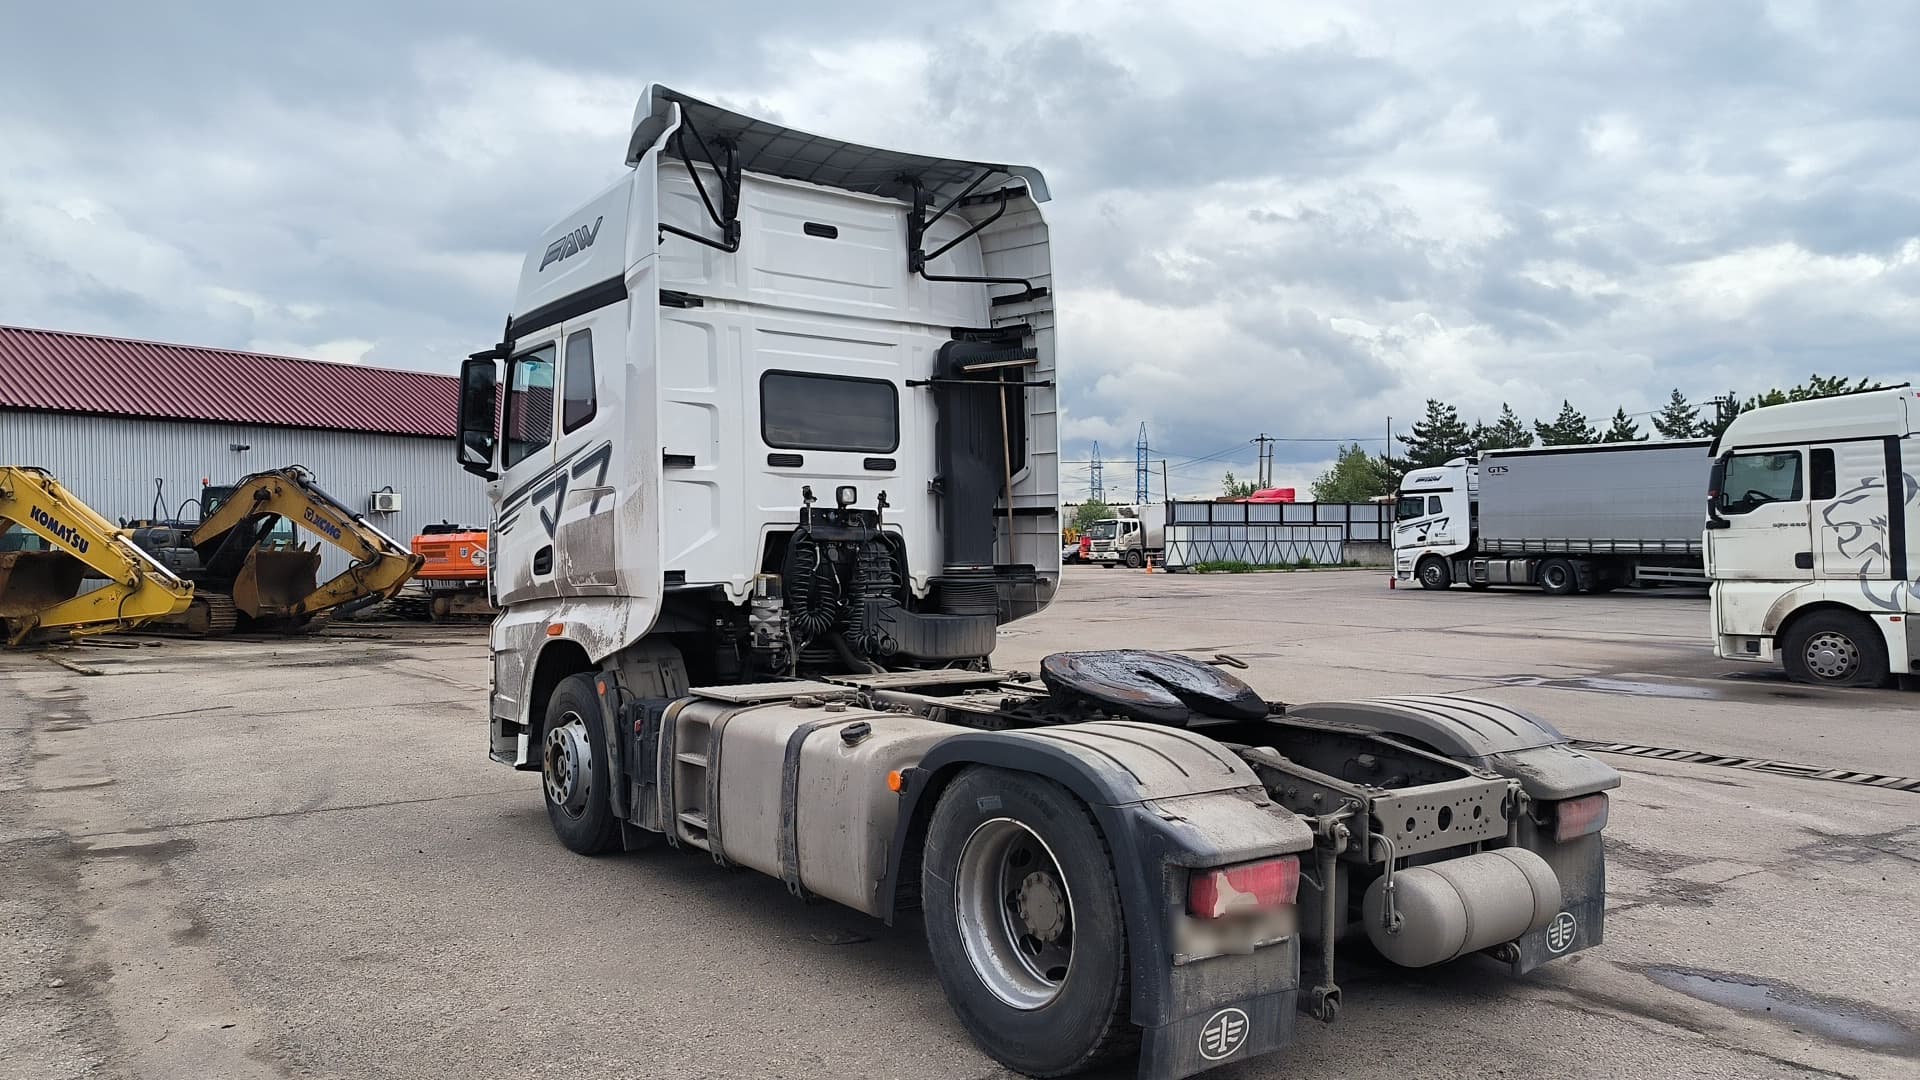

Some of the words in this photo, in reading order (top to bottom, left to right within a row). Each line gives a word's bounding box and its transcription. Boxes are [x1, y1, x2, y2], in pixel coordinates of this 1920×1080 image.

[539, 215, 603, 272] FAW
[1487, 465, 1509, 474] GTS
[30, 504, 89, 554] KOMATSU
